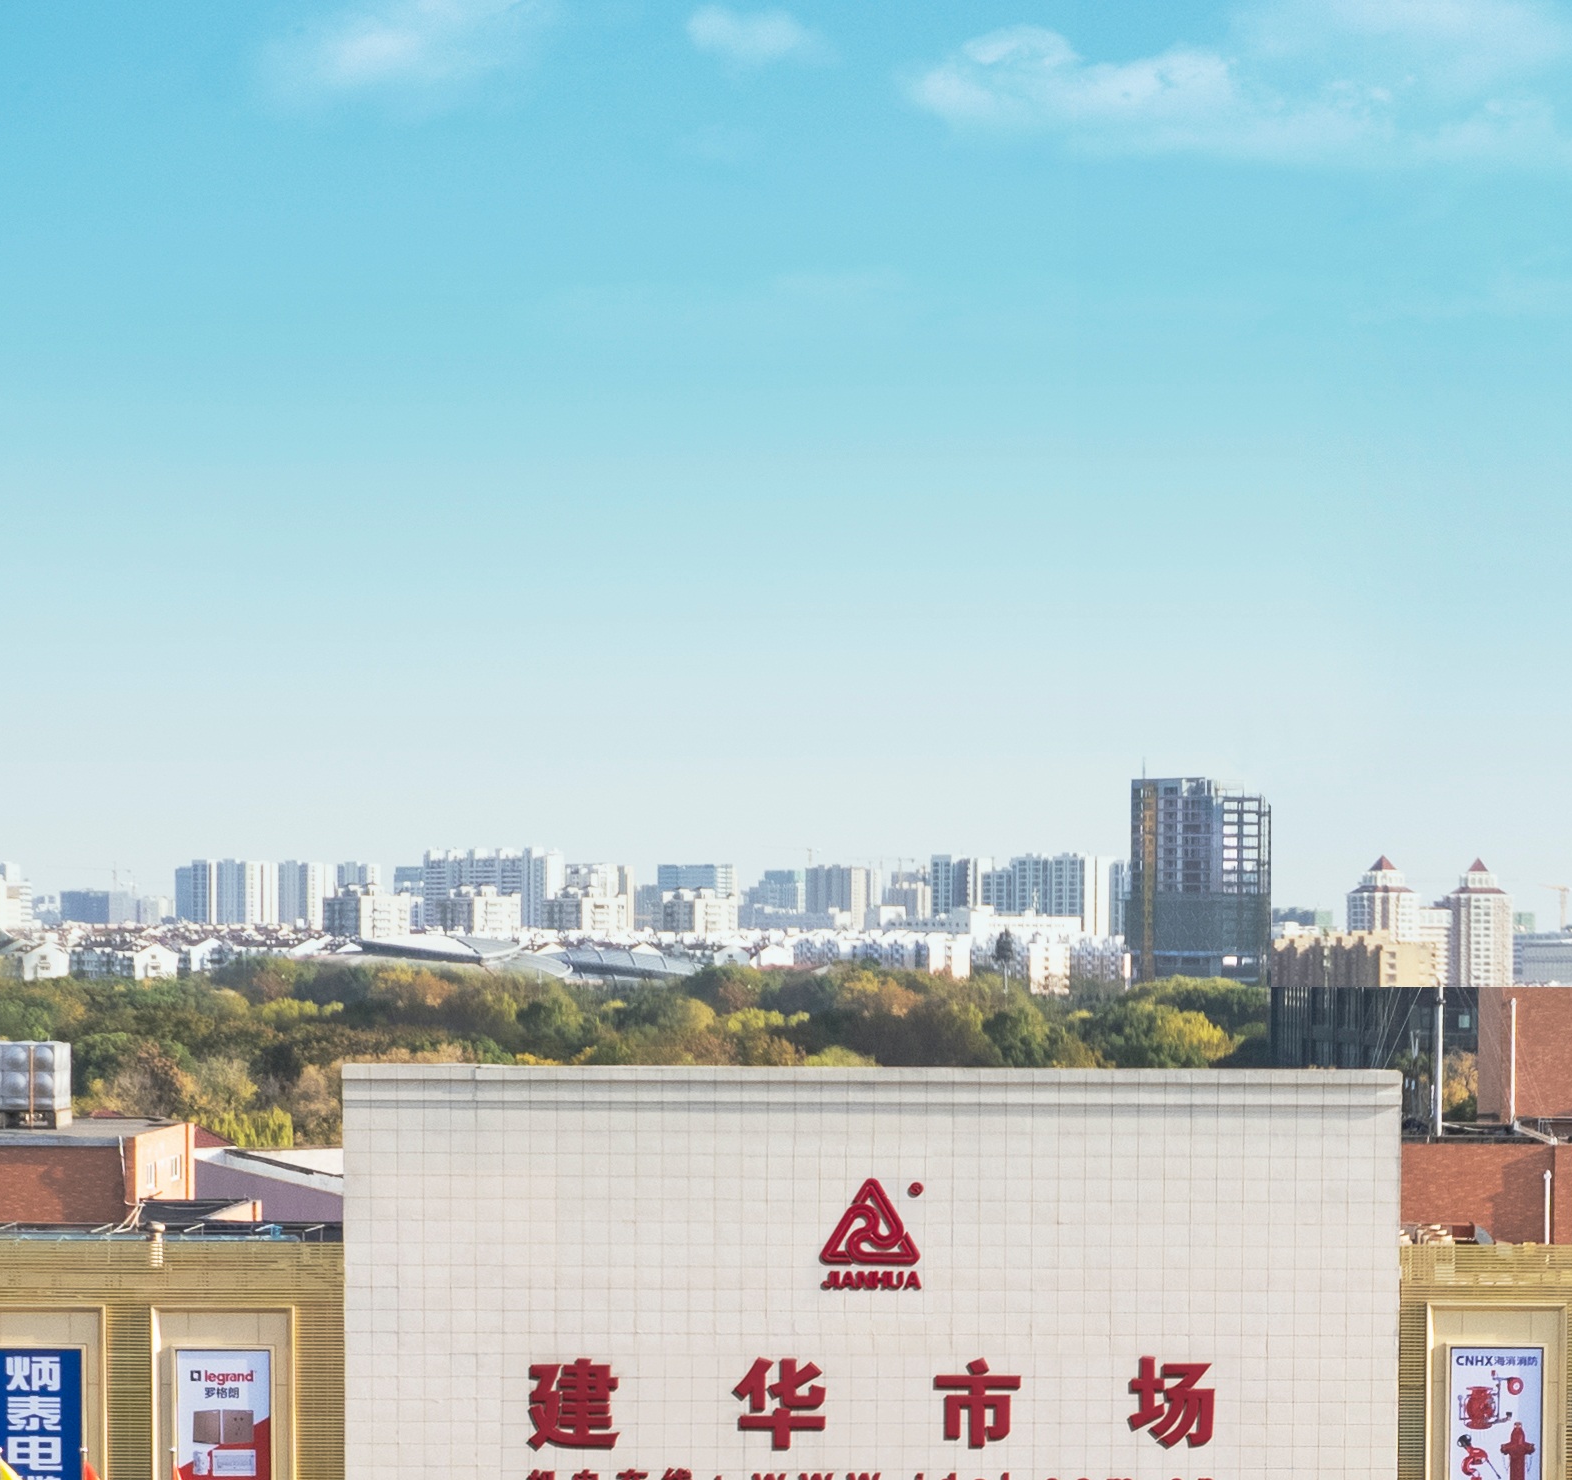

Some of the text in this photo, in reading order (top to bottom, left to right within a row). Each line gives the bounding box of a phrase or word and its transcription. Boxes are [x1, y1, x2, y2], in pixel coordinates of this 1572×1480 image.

[821, 1270, 922, 1291] JIANHUA
[1456, 1355, 1494, 1367] CNHX
[204, 1370, 254, 1385] legrand
[204, 1388, 240, 1400] 罗格朗
[527, 1356, 1215, 1451] 建华市场
